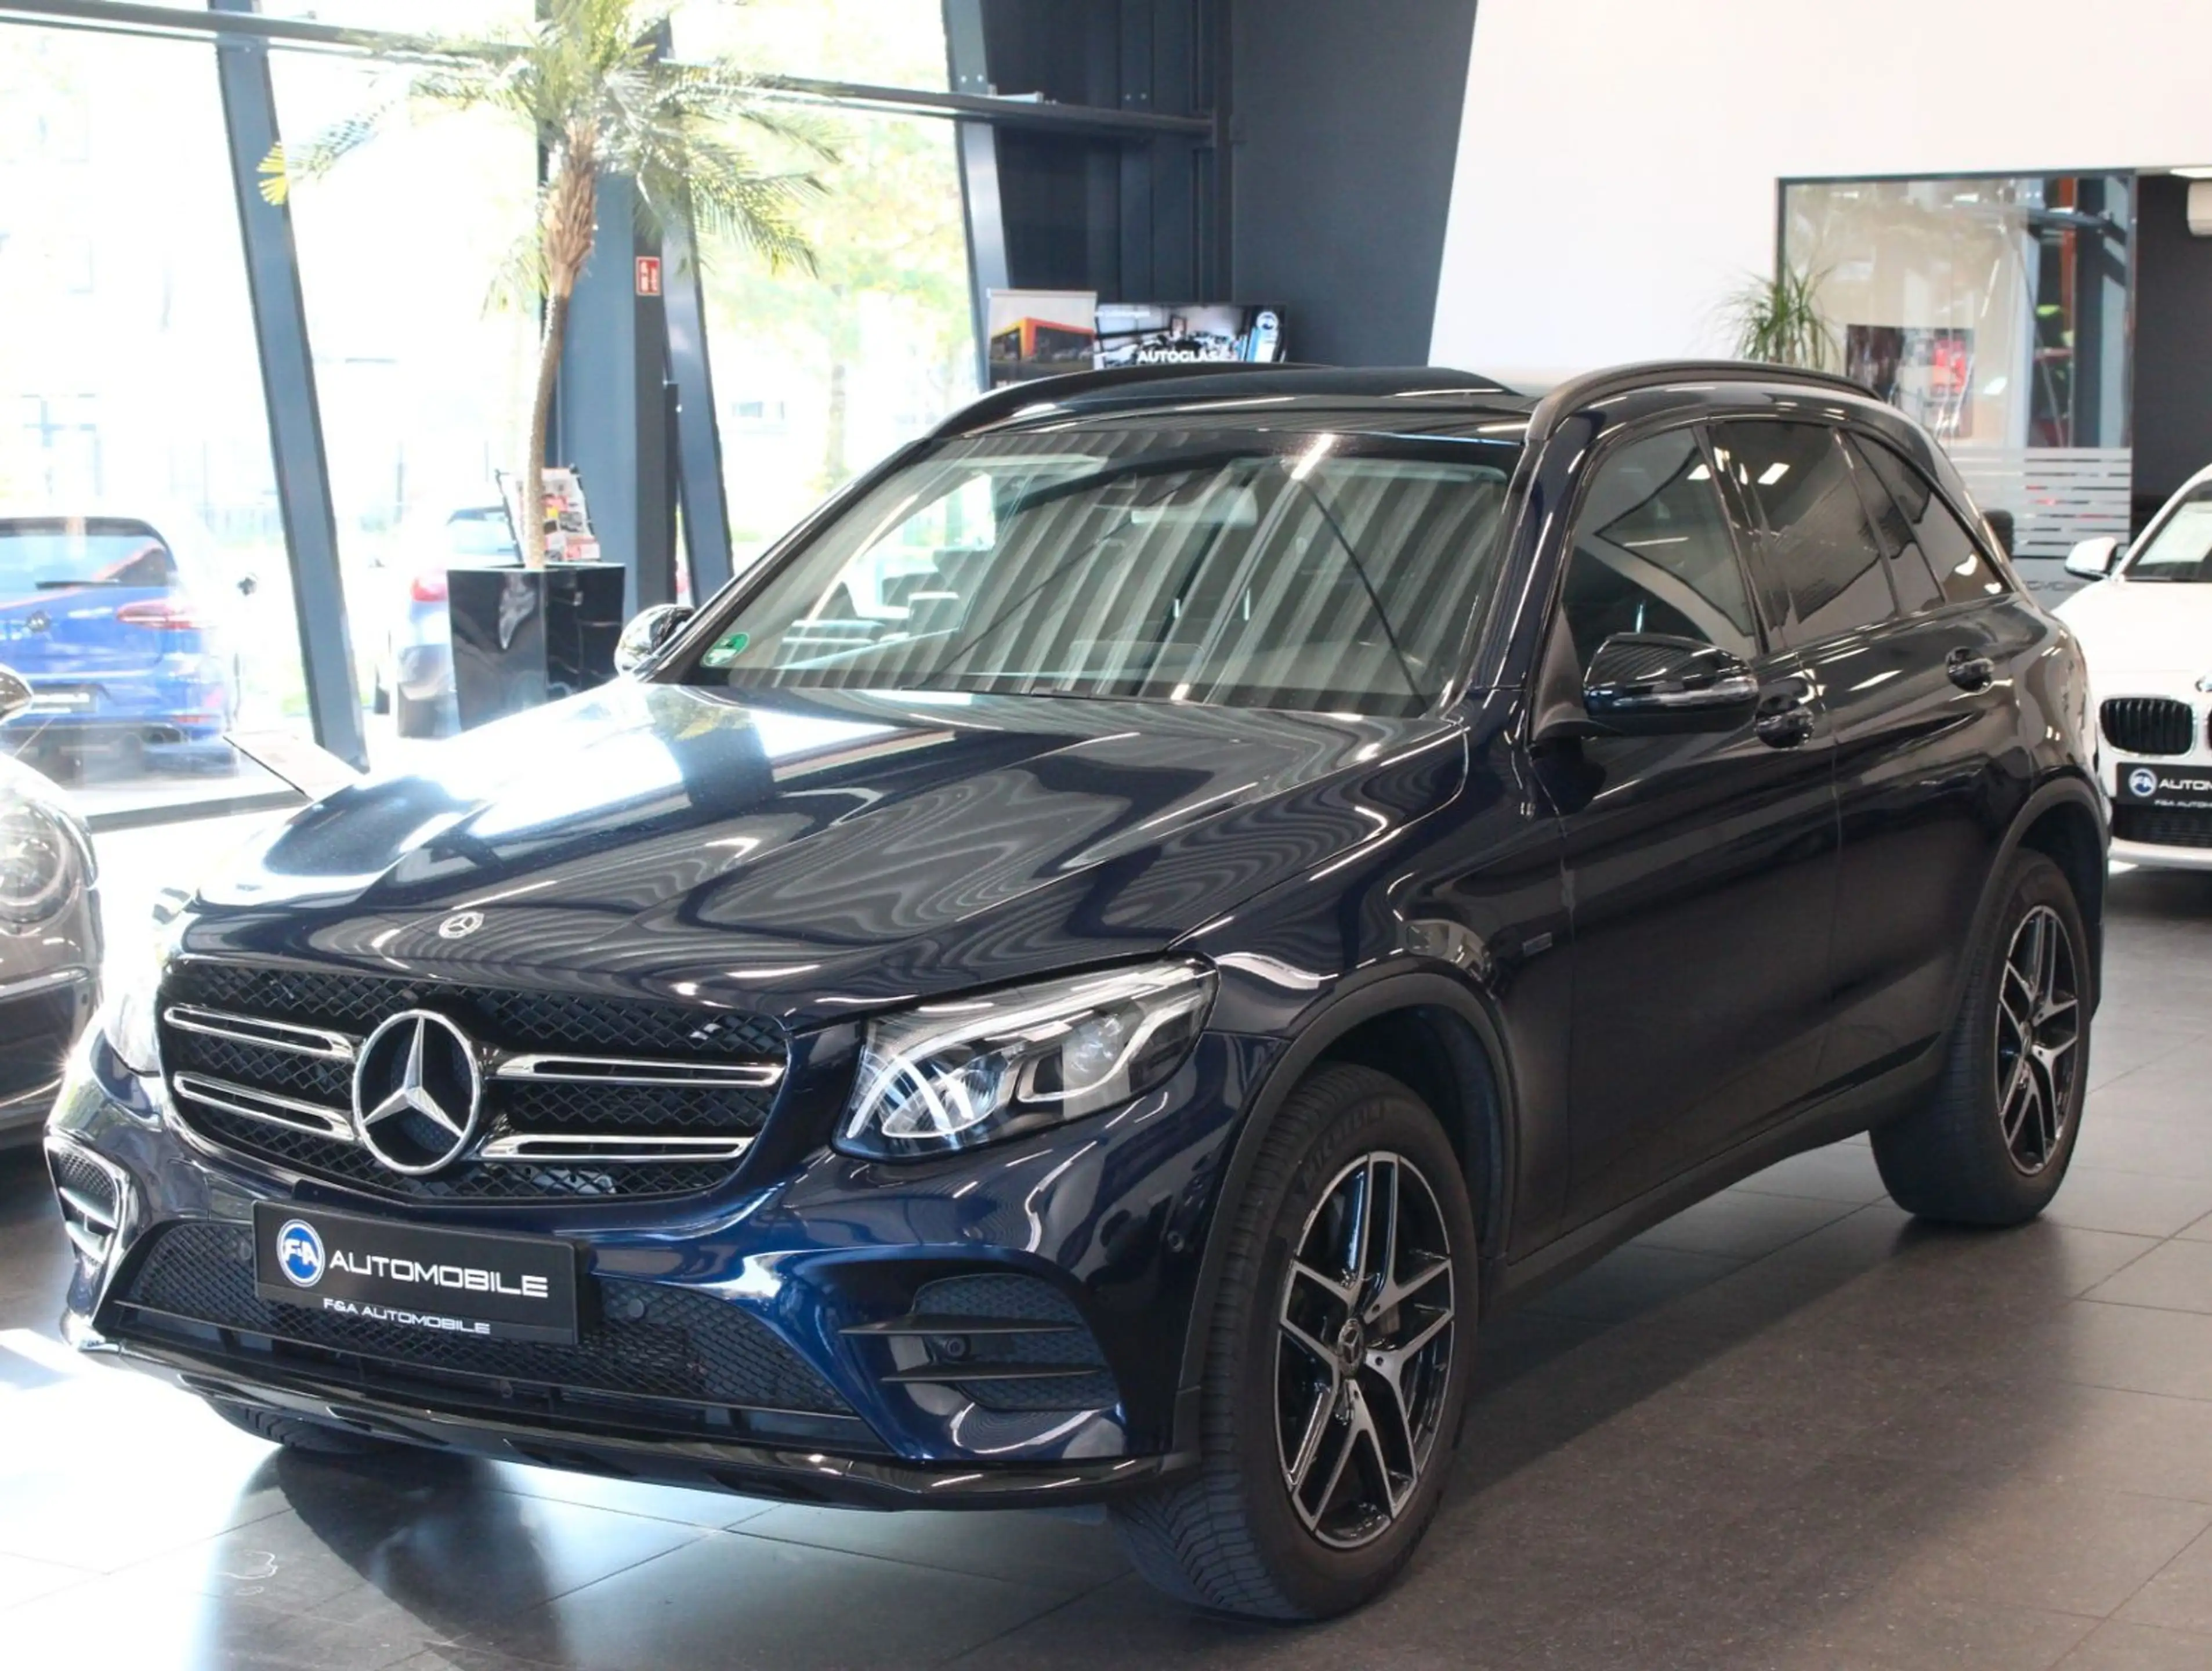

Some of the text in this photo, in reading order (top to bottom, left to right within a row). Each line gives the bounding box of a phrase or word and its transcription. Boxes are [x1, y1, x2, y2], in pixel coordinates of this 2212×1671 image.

[329, 1249, 548, 1298] AUTOMOBILE
[323, 1297, 491, 1334] F&A AUTOMOBILE
